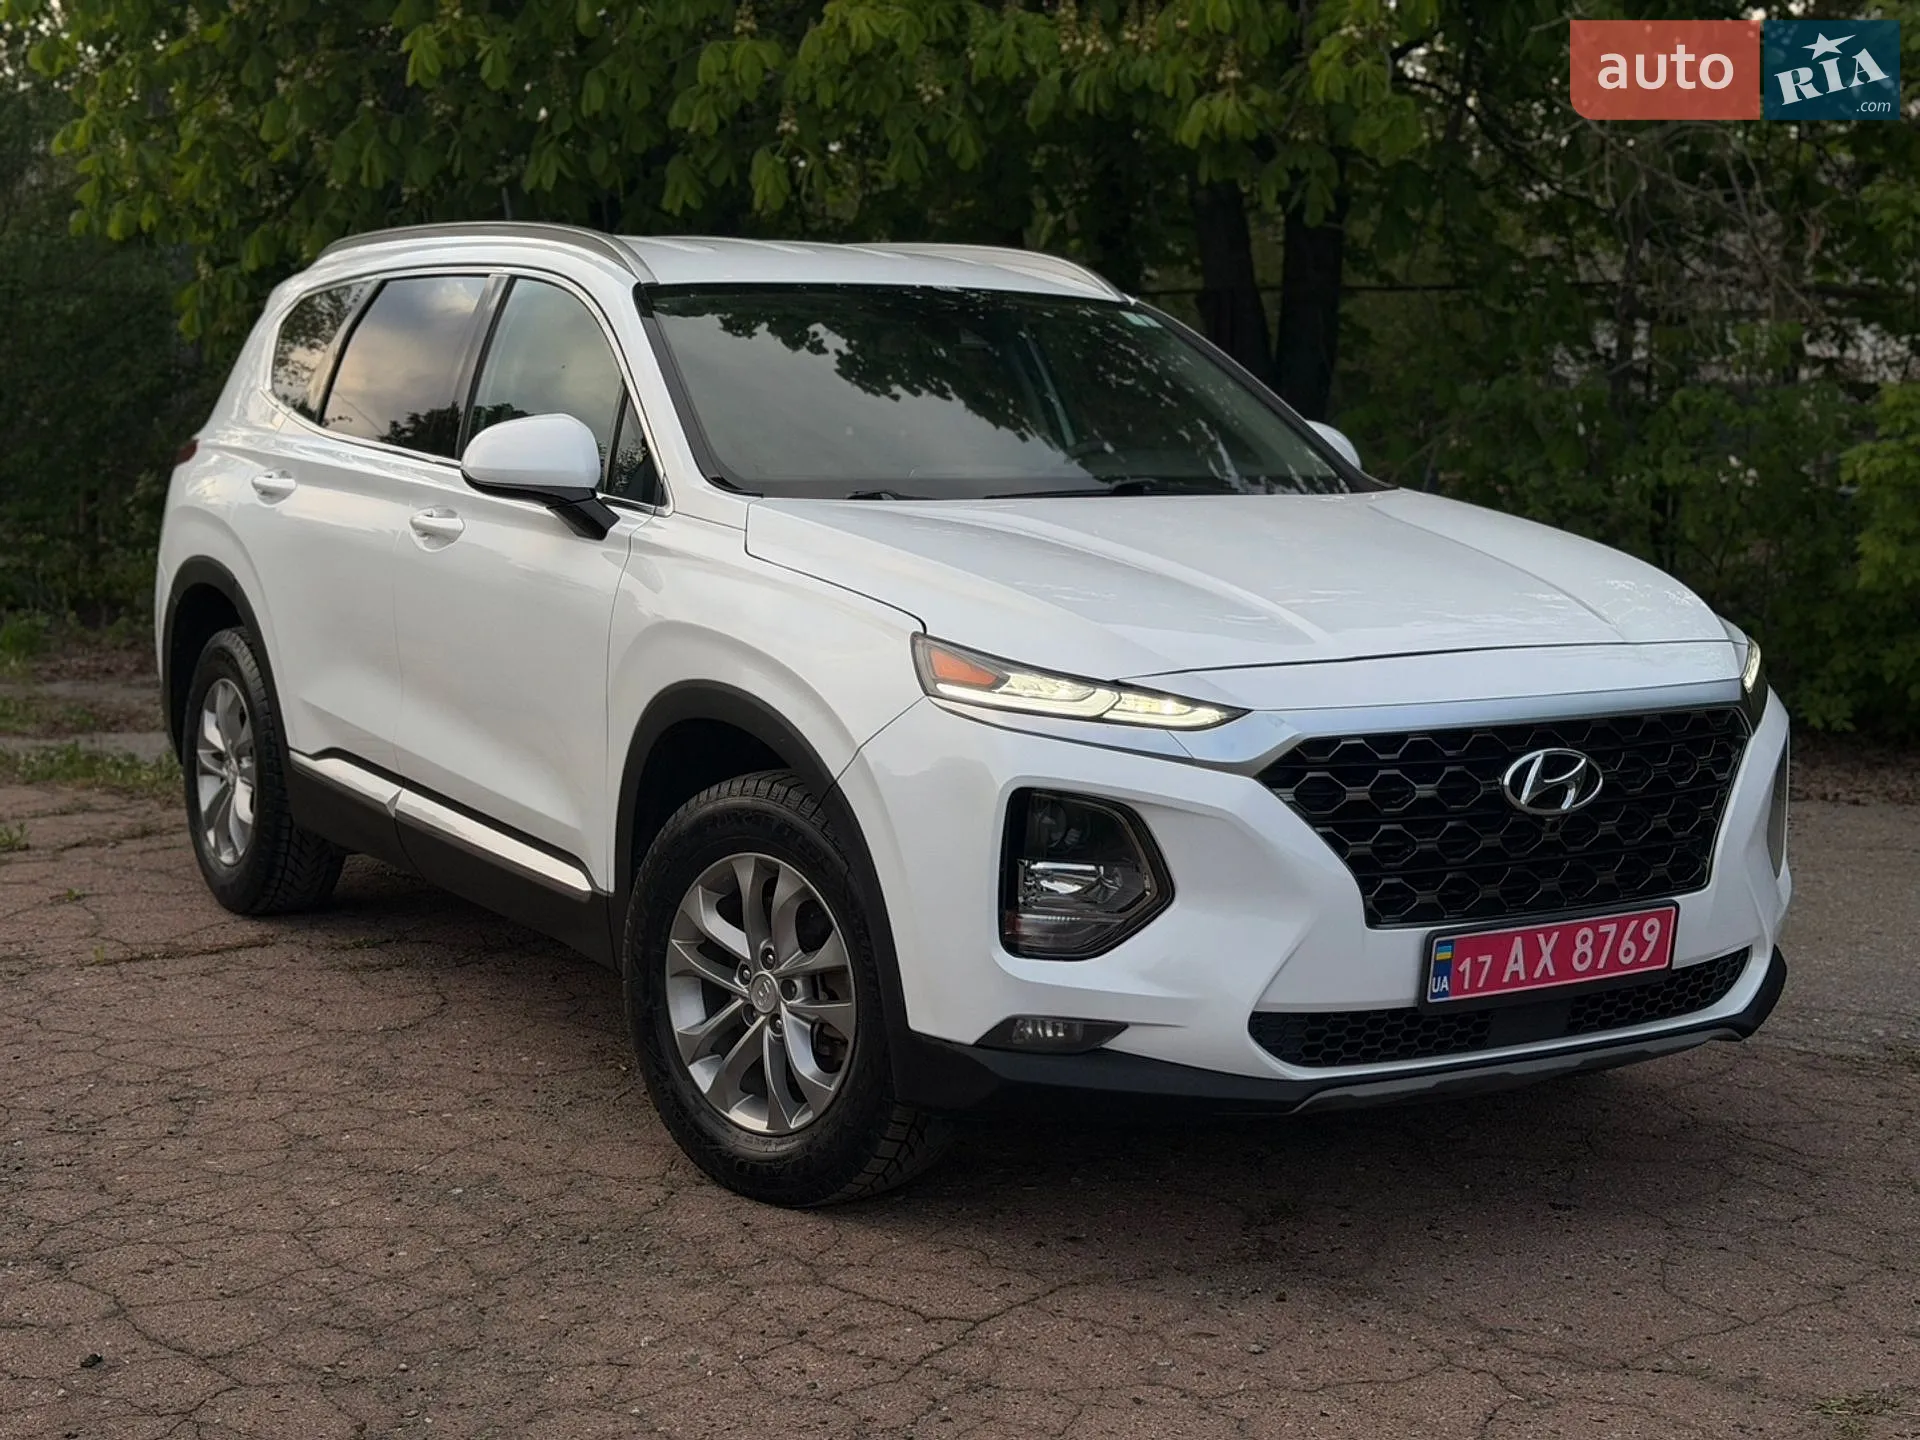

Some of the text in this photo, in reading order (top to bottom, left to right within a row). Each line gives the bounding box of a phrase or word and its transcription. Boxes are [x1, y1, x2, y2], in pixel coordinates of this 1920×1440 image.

[1457, 917, 1661, 990] 17 AX 8769
[1432, 976, 1449, 993] UA
